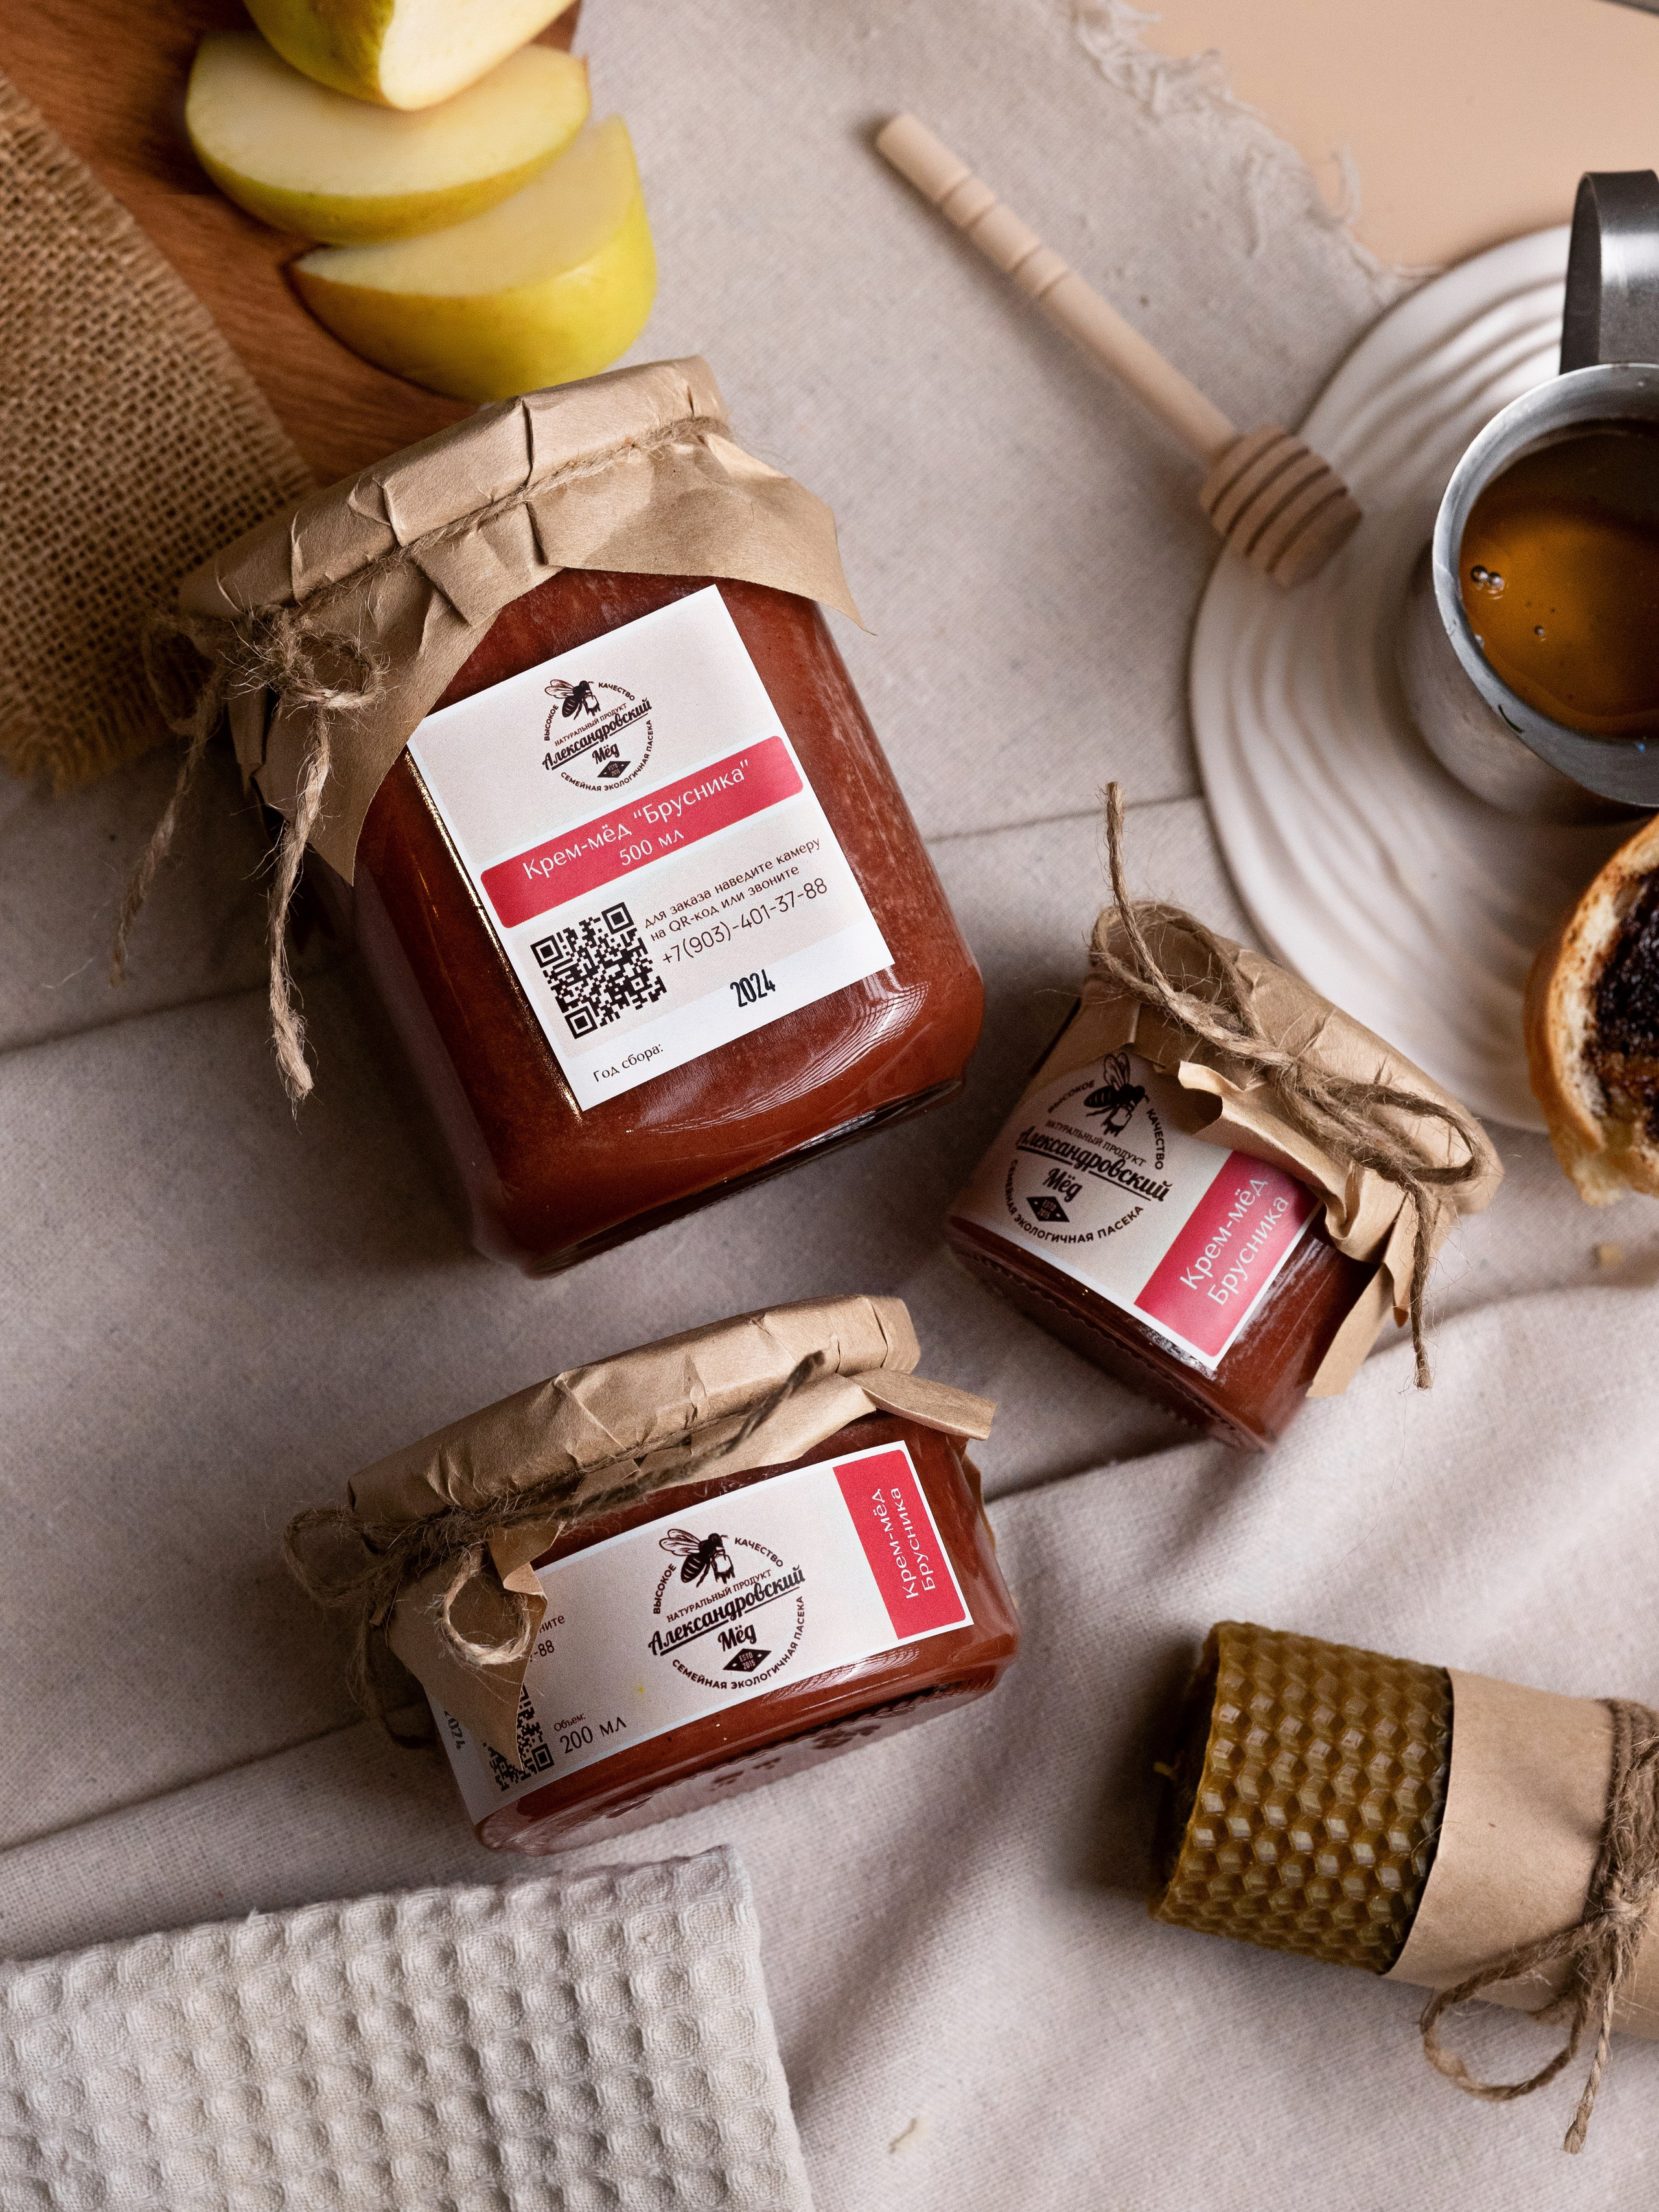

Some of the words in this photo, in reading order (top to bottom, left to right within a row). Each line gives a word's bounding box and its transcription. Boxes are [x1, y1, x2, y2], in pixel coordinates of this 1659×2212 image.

[542, 697, 652, 770] Александровский
[544, 704, 559, 741] ВЫСОКОЕ
[599, 682, 635, 701] КАЧЕСТВО
[554, 718, 599, 747] НАТУРАЛЬНЫЙ
[599, 703, 627, 721] ПРОДУКТ
[561, 772, 601, 791] СЕМЕЙНАЯ
[604, 753, 650, 791] ЭКОЛОГИЧНАЯ
[592, 743, 620, 765] Мёд
[522, 824, 632, 879] Крем-мёд
[620, 839, 653, 866] 500
[658, 829, 684, 849] мл
[645, 911, 667, 929] для
[669, 890, 712, 915] заказа
[714, 861, 773, 894] наведите
[776, 837, 820, 865] камеру
[651, 929, 666, 942] на
[669, 905, 719, 932] QR-код
[721, 891, 745, 909] или
[748, 866, 800, 896] звоните
[662, 878, 828, 964] +7(903)-401-37-88
[730, 969, 776, 1008] 2024
[593, 1066, 620, 1082] Год
[622, 1044, 663, 1069] сбора:
[1016, 1126, 1173, 1202] Александровский
[1102, 1141, 1147, 1167] ПРОДУКТ
[1146, 1108, 1165, 1170] КАЧЕСТВО
[1043, 1168, 1083, 1202] Мёд
[1014, 1214, 1094, 1244] ЭКОЛОГИЧНАЯ
[1097, 1205, 1144, 1239] ПАСЕКА
[1179, 1180, 1268, 1290] Крем-мёд
[1207, 1197, 1290, 1305] Брусника
[872, 1488, 919, 1599] Крем-мёд
[890, 1487, 936, 1591] Брусника
[653, 1563, 677, 1614] ВЫСОКОЕ
[735, 1537, 783, 1567] КАЧЕСТВО
[666, 1587, 732, 1623] НАТУРАЛЬНЫЙ
[733, 1569, 771, 1593] ПРОДУКТ
[648, 1565, 806, 1656] Александровский
[717, 1624, 758, 1652] Мёд
[672, 1659, 728, 1690] СЕМЕЙНАЯ
[730, 1642, 798, 1690] ЭКОЛОГИЧНАЯ
[793, 1596, 805, 1640] ПАСЕКА
[742, 1660, 756, 1670] 2015
[554, 1713, 586, 1732] Объем:
[560, 1725, 593, 1754] 200
[599, 1716, 627, 1737] мл
